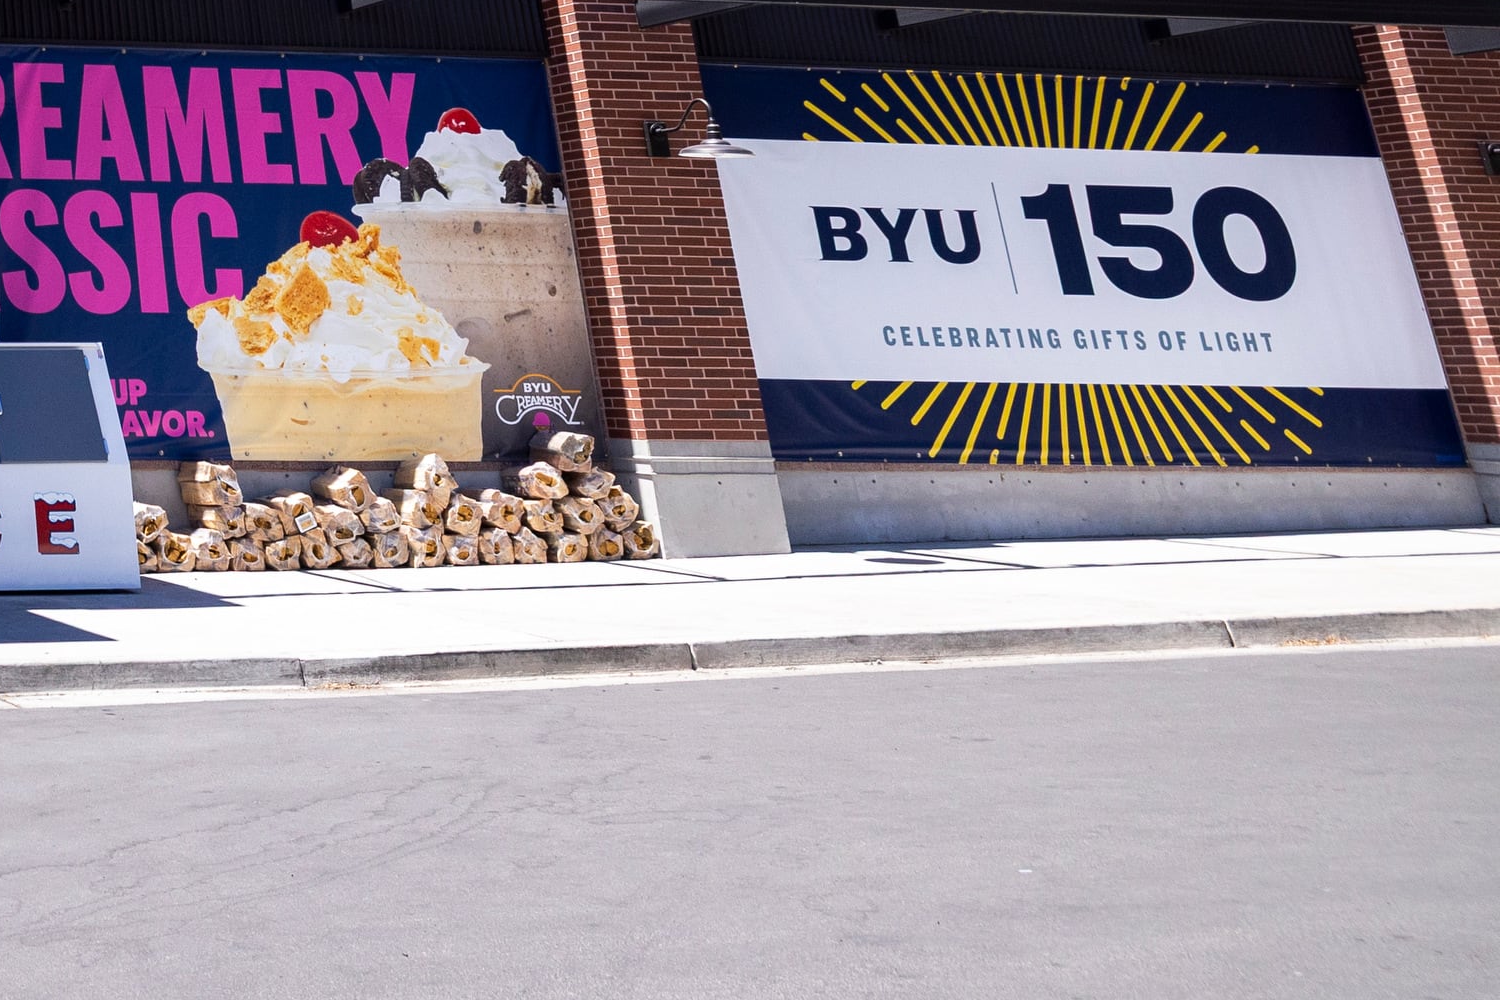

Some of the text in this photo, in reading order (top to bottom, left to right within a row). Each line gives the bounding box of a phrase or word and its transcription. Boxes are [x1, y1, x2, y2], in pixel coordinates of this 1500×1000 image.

[809, 183, 1297, 302] BYU 150
[882, 325, 1274, 353] CELEBRATING GIFTS OF LIGHT
[523, 382, 551, 393] BYU
[495, 394, 582, 425] CREAMERY
